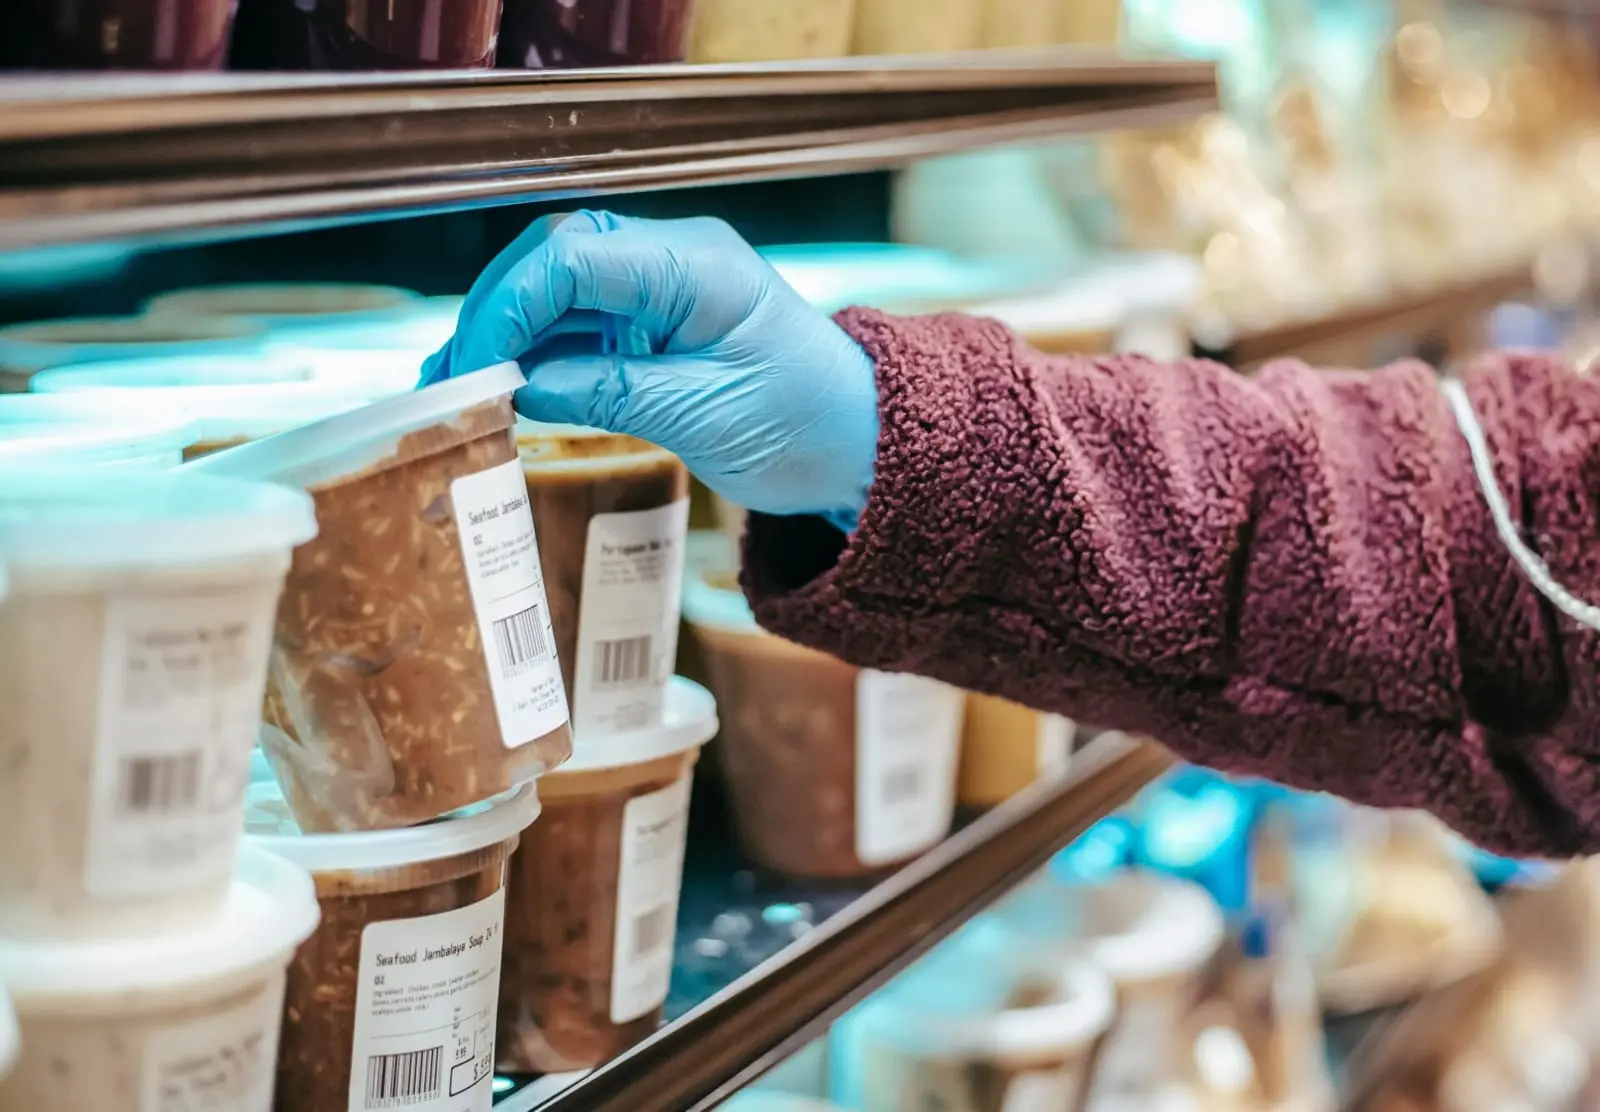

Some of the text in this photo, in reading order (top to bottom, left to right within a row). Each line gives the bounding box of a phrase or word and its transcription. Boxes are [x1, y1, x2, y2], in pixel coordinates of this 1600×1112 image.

[468, 505, 499, 525] Seafood
[376, 949, 417, 967] Seafood
[423, 942, 466, 962] Jambalaya
[469, 934, 484, 949] Soup
